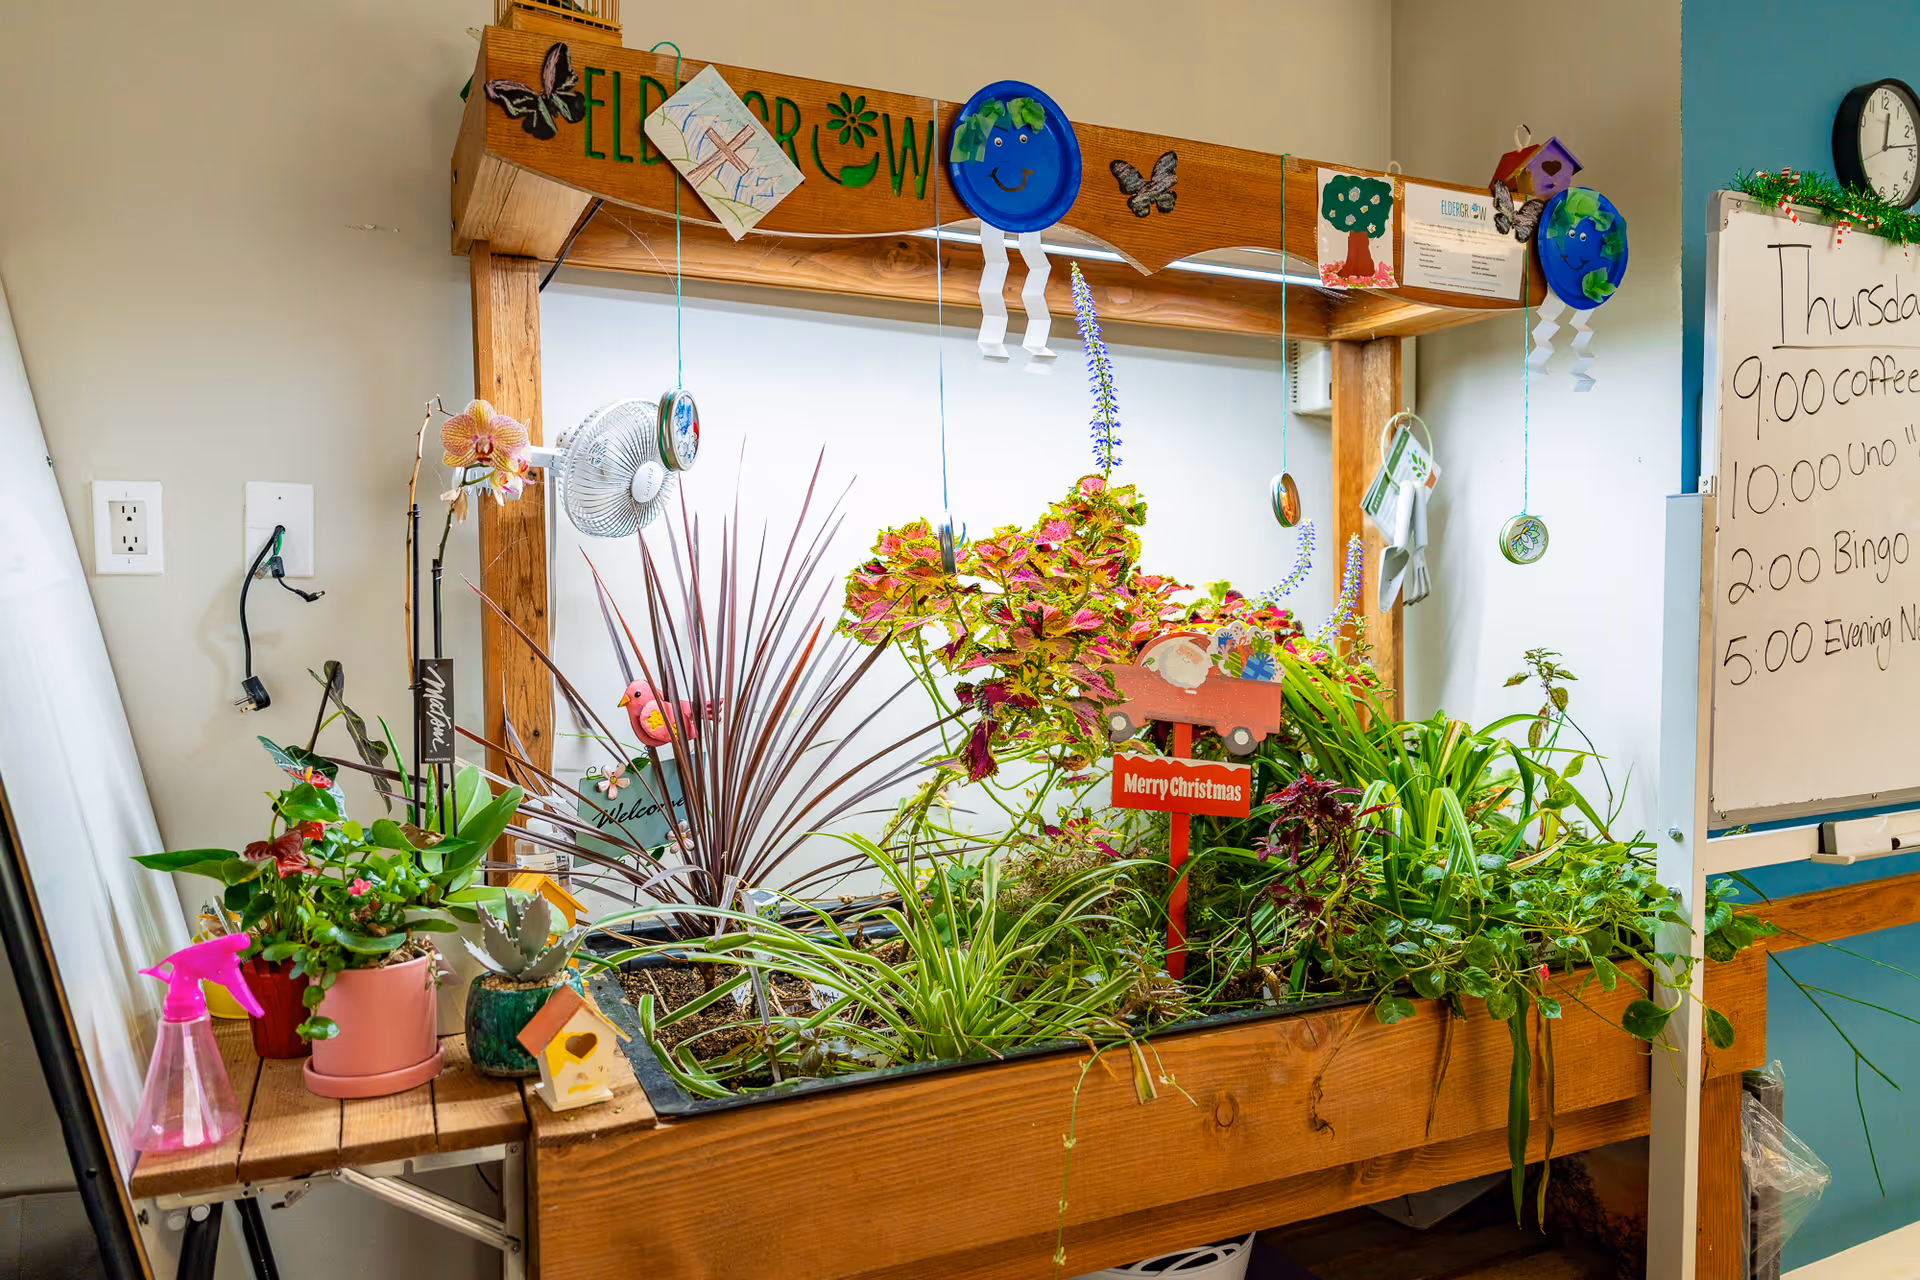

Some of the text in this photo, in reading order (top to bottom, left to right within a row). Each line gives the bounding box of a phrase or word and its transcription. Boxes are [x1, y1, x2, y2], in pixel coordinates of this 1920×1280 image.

[1869, 99, 1874, 113] 11
[1881, 96, 1889, 110] 12
[1904, 125, 1910, 138] 2
[1908, 148, 1914, 161] 3
[1903, 170, 1909, 183] 4
[1893, 184, 1899, 196] 5
[1733, 355, 1825, 440] 9:00
[1732, 453, 1841, 520] 10:00
[1728, 529, 1910, 605] 2:00 Bingo
[1723, 621, 1813, 685] 5:00
[1824, 614, 1892, 672] Evening
[1123, 772, 1242, 802] Merry Christmas
